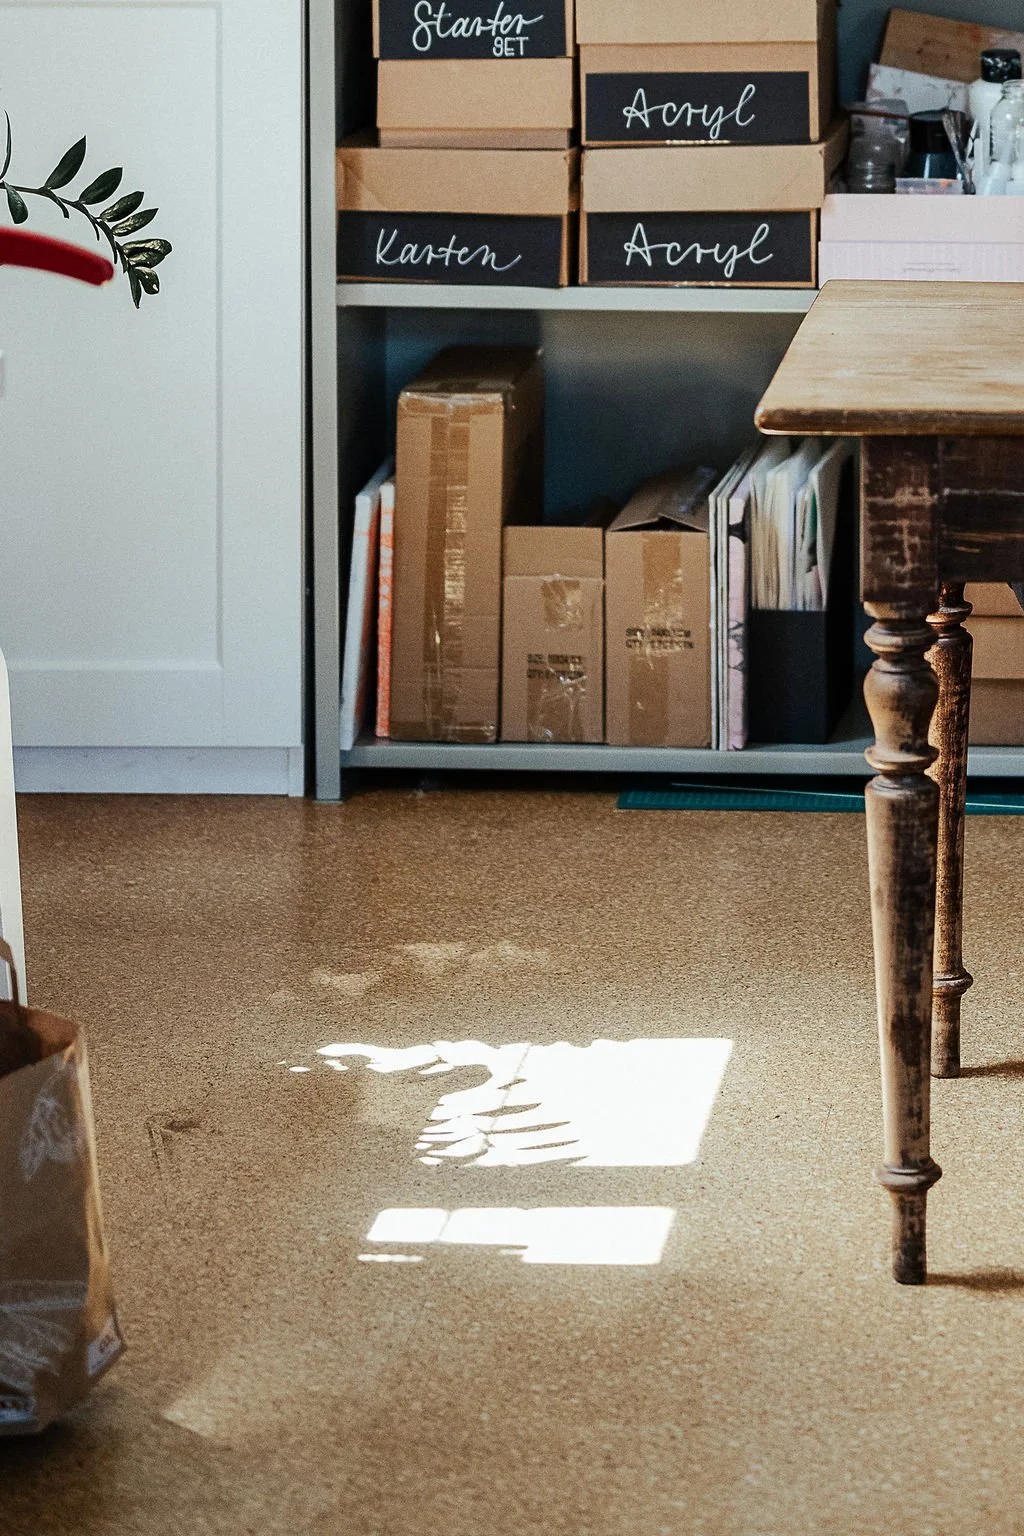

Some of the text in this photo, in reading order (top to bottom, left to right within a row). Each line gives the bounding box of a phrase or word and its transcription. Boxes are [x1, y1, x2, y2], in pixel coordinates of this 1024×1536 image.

[412, 0, 544, 52] Starter
[492, 36, 529, 57] SET
[622, 83, 756, 140] Acryl
[375, 228, 523, 271] Karten
[623, 222, 774, 278] Acryl
